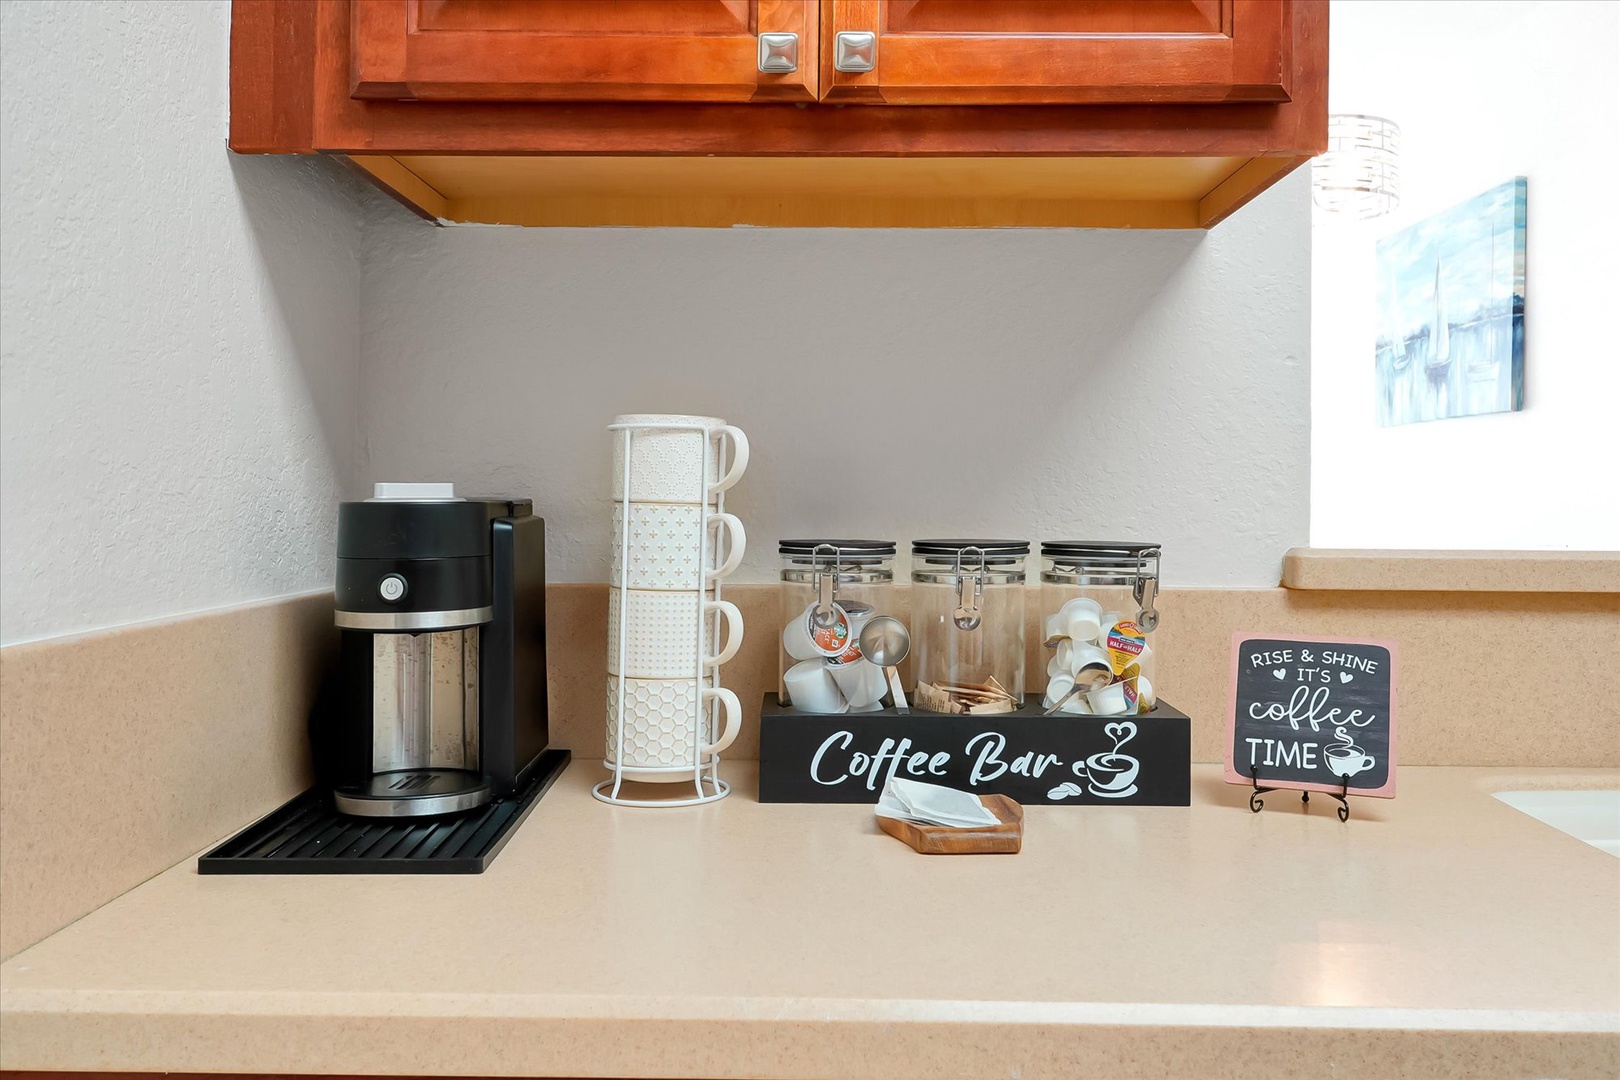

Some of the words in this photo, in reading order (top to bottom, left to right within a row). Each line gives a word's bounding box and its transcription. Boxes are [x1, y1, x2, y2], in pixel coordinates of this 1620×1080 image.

[1250, 649, 1294, 668] RISE
[1300, 648, 1315, 663] &
[1321, 650, 1379, 675] SHINE
[1296, 667, 1331, 683] IT'S
[1248, 685, 1376, 733] coffee
[810, 730, 952, 791] Coffee
[964, 731, 1064, 786] Bar
[1245, 737, 1319, 769] TIME
